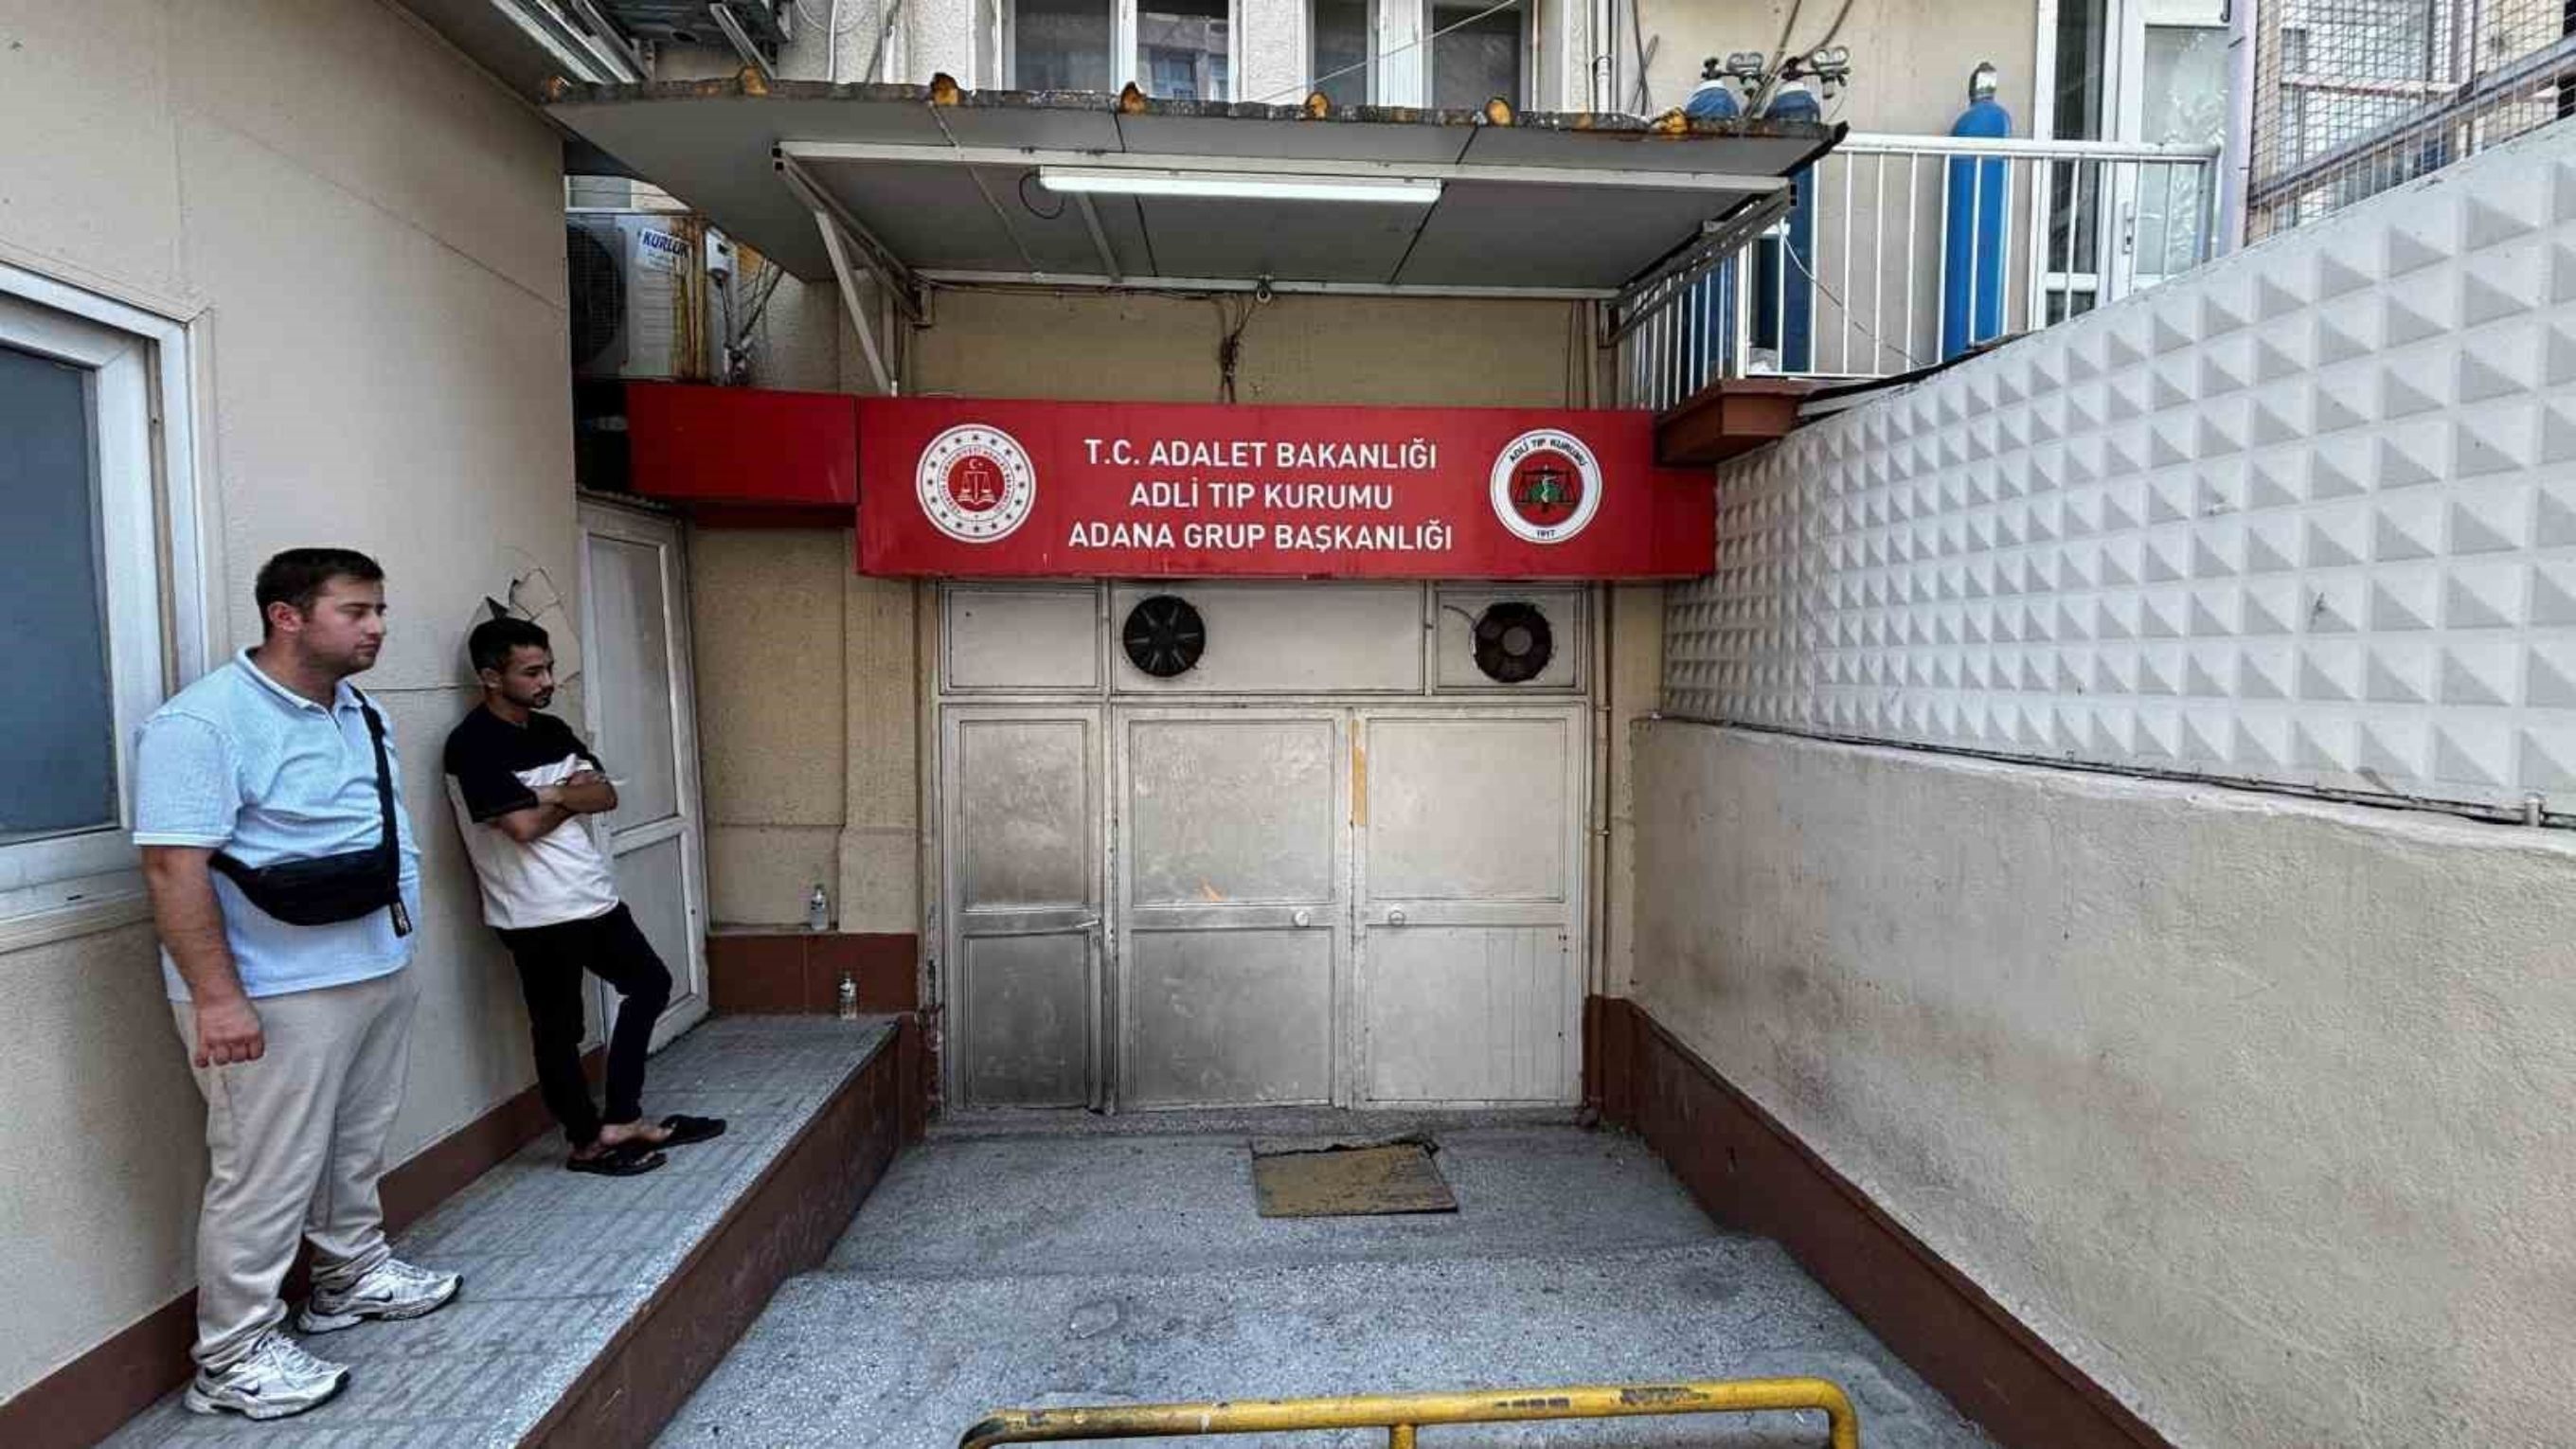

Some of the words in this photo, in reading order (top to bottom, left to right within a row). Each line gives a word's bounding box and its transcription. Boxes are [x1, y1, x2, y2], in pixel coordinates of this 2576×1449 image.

[1083, 438, 1140, 466] T.C.
[1149, 440, 1268, 468] ADALET
[1277, 438, 1437, 470] BAKANLIĞI
[1509, 438, 1530, 462] ADLİ
[1530, 438, 1547, 448] TIP
[1549, 438, 1588, 466] KURUMU
[1129, 476, 1199, 509] ADLİ
[1208, 482, 1256, 509] TIP
[1264, 483, 1393, 510] KURUMU
[1068, 522, 1175, 548] ADANA
[1184, 523, 1266, 549] GRUP
[1275, 519, 1452, 553] BAŞKANLIĞI
